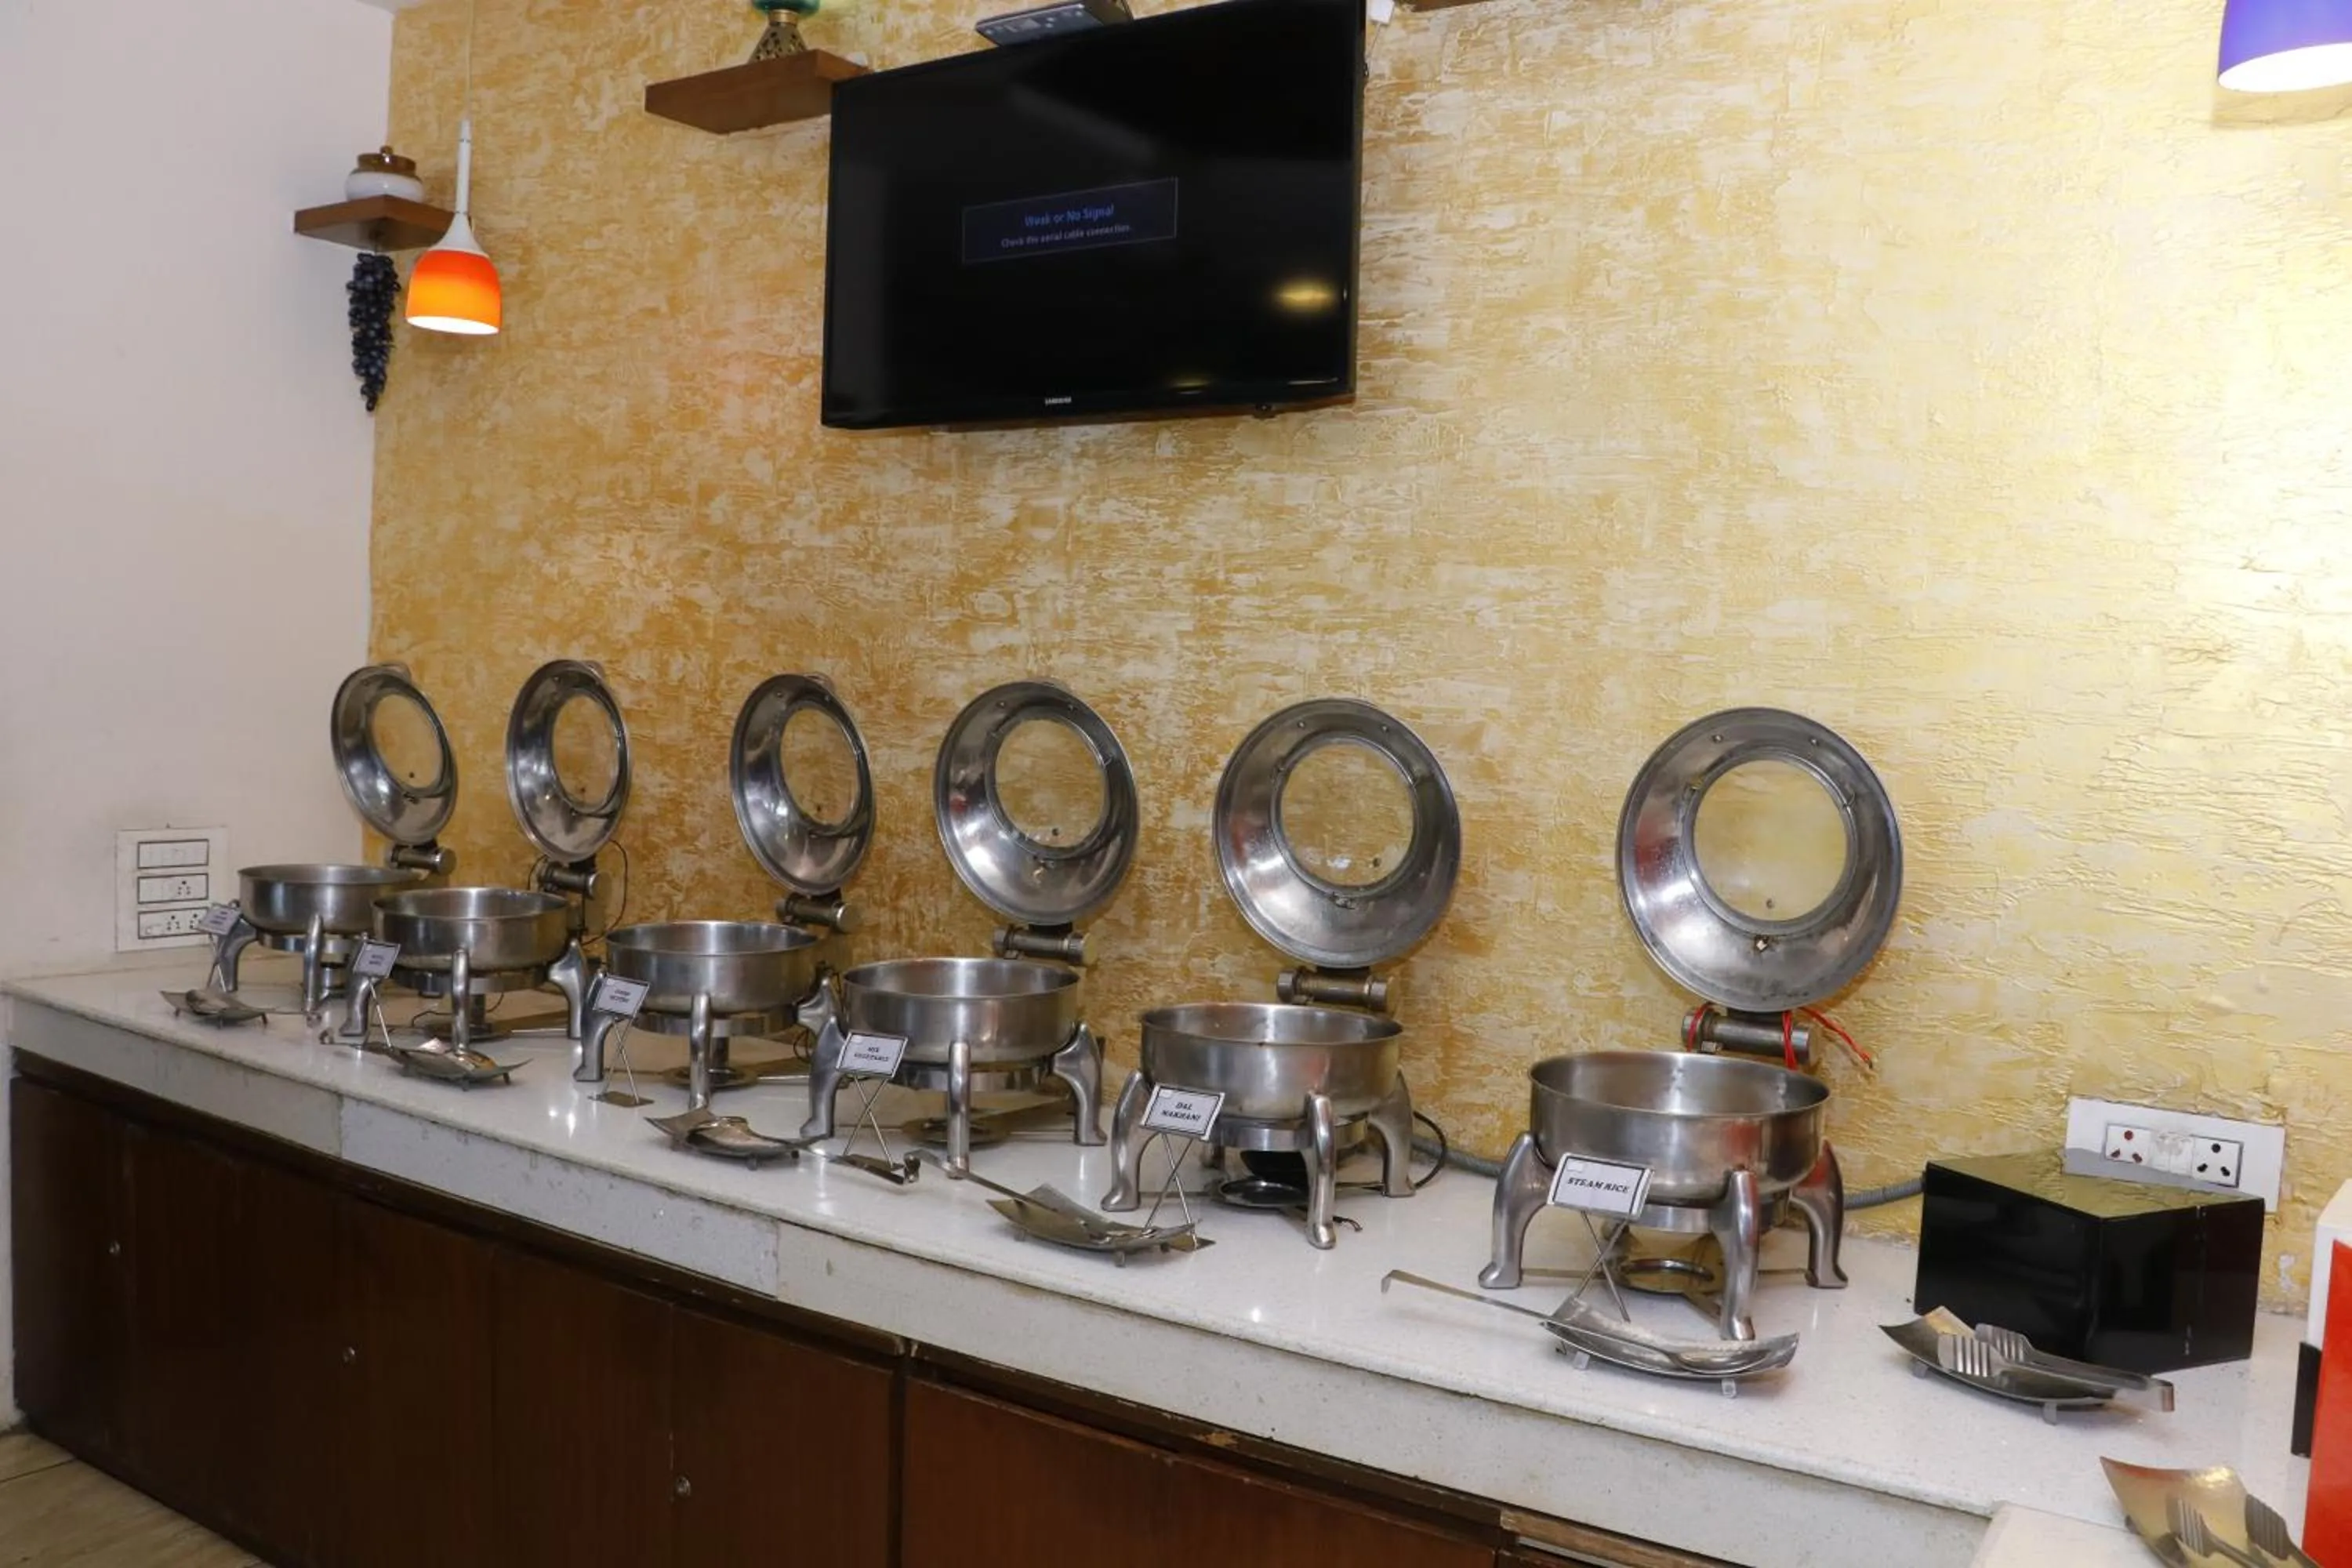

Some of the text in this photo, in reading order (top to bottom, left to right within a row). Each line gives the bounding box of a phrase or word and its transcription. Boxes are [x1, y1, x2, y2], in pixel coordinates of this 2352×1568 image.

[1053, 214, 1064, 224] or
[1067, 210, 1080, 222] No
[1082, 204, 1115, 222] Signal
[1175, 1102, 1192, 1110] DAL
[1567, 1177, 1630, 1193] STEAM RICE
